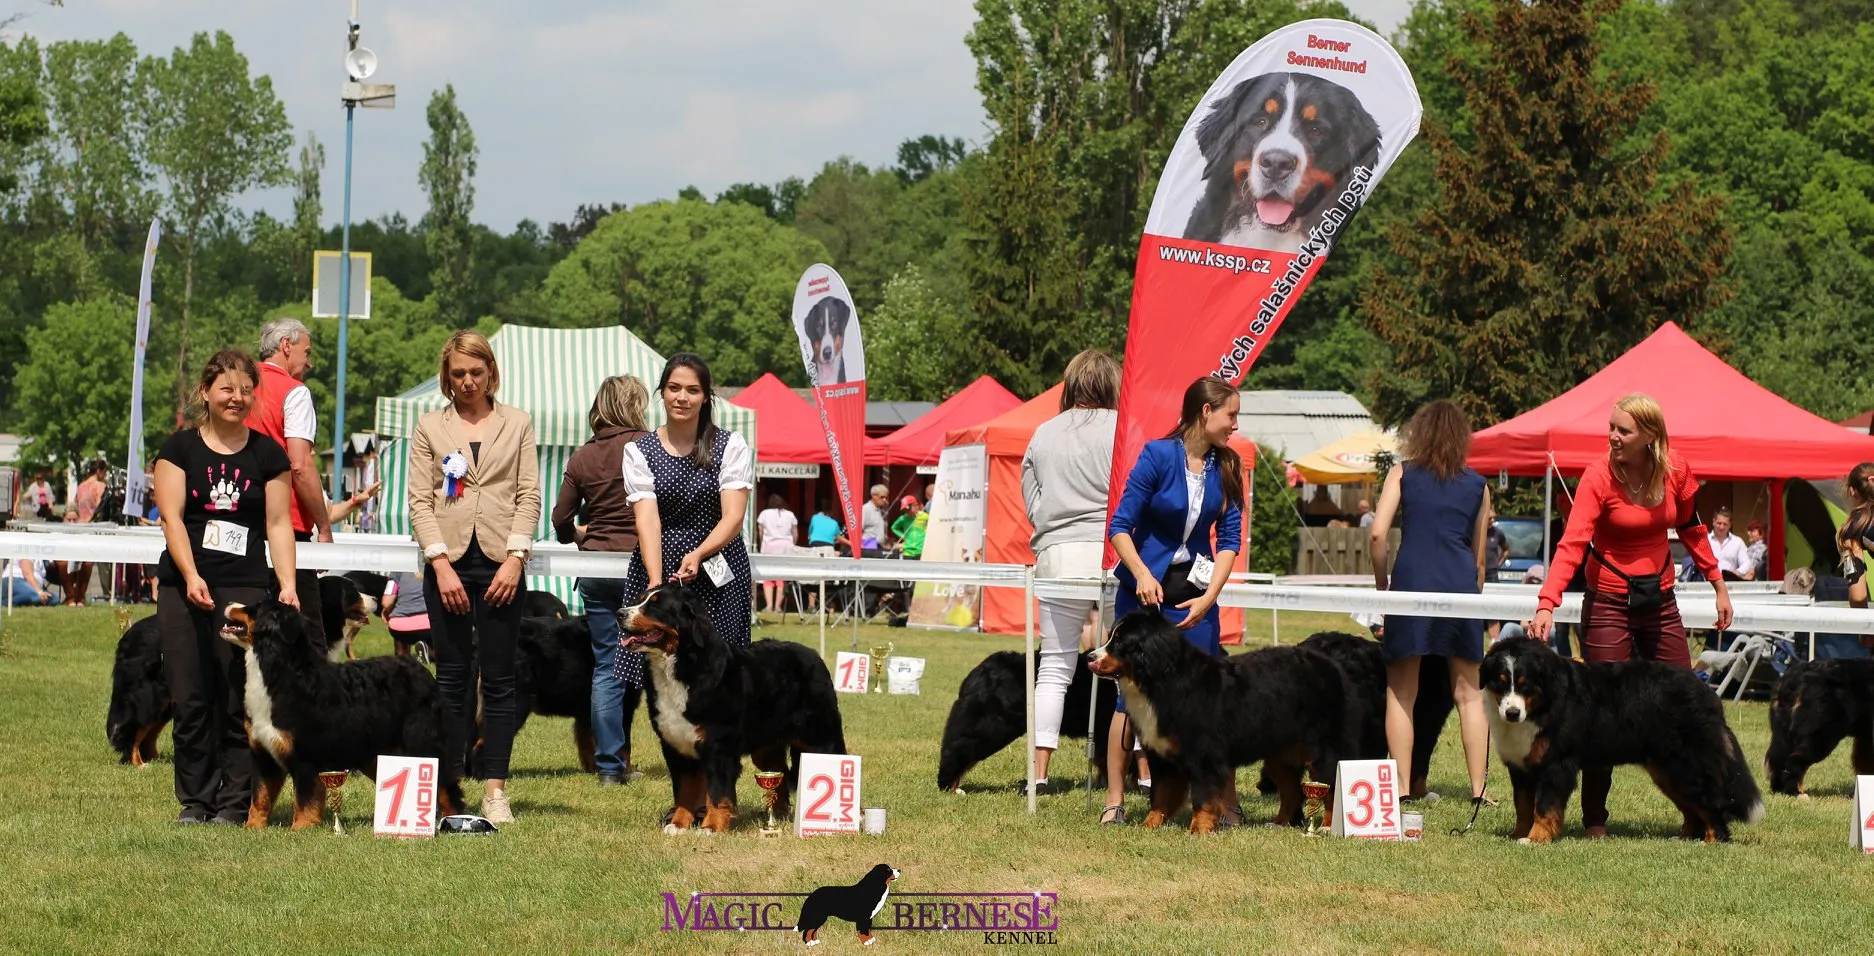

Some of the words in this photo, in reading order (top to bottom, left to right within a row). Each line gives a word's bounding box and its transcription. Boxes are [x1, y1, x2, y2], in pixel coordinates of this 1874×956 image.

[1287, 51, 1367, 74] Sennenhund
[1307, 34, 1351, 52] Berner
[1159, 245, 1271, 274] www.kssp.cz
[1210, 335, 1256, 382] kých
[1250, 206, 1344, 335] salašnických
[1338, 165, 1373, 211] psů
[839, 658, 855, 689] 1.
[856, 656, 866, 690] GIOM
[380, 767, 411, 828] 1.
[416, 763, 433, 827] GIOM
[804, 774, 837, 822] 2.
[839, 760, 854, 822] GIOM
[1346, 779, 1378, 828] 3.
[1377, 764, 1395, 826] GIOM
